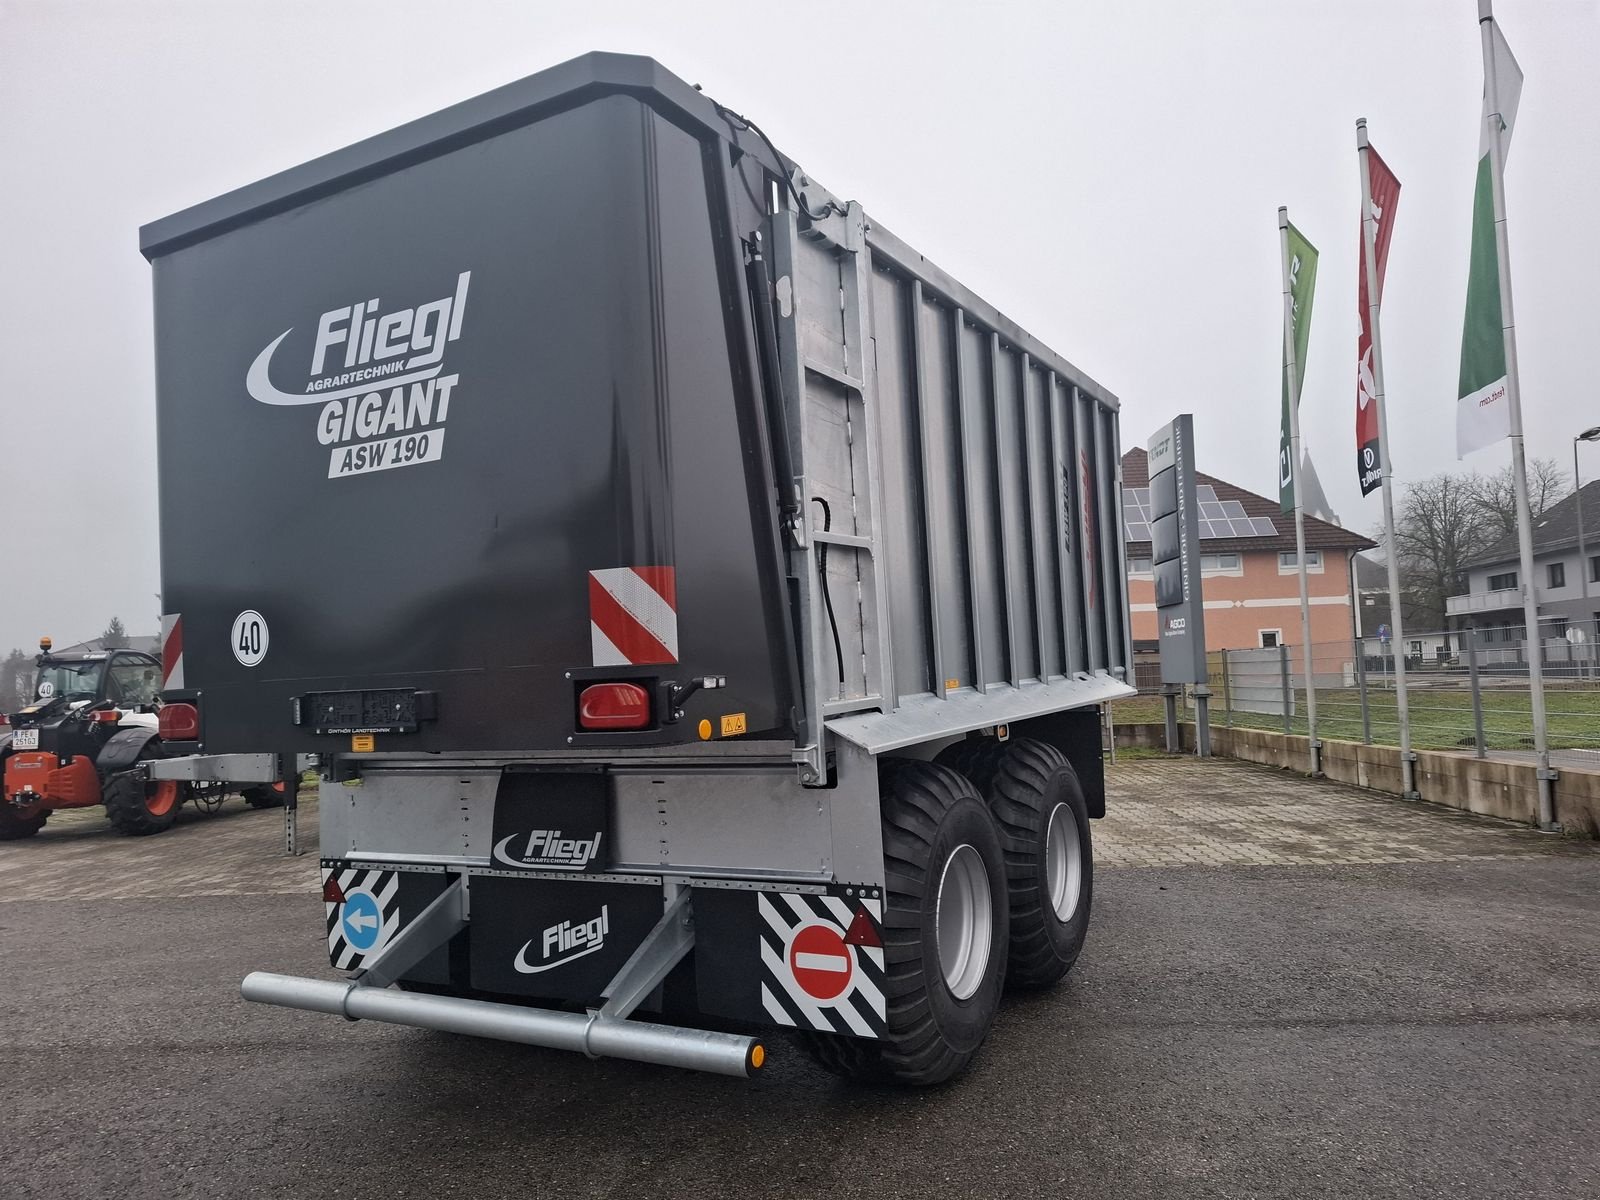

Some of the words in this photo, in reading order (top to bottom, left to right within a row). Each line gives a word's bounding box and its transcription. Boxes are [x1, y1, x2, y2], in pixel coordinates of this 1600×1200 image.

[311, 271, 471, 376] Fliegl
[306, 360, 407, 393] AGRARTECHNIK
[317, 374, 459, 445] GIGANT
[340, 442, 387, 473] ASW
[390, 434, 429, 465] 190
[239, 621, 261, 655] 40
[41, 685, 51, 695] 40
[525, 830, 602, 864] Fliegl
[543, 904, 609, 958] Fliegl
